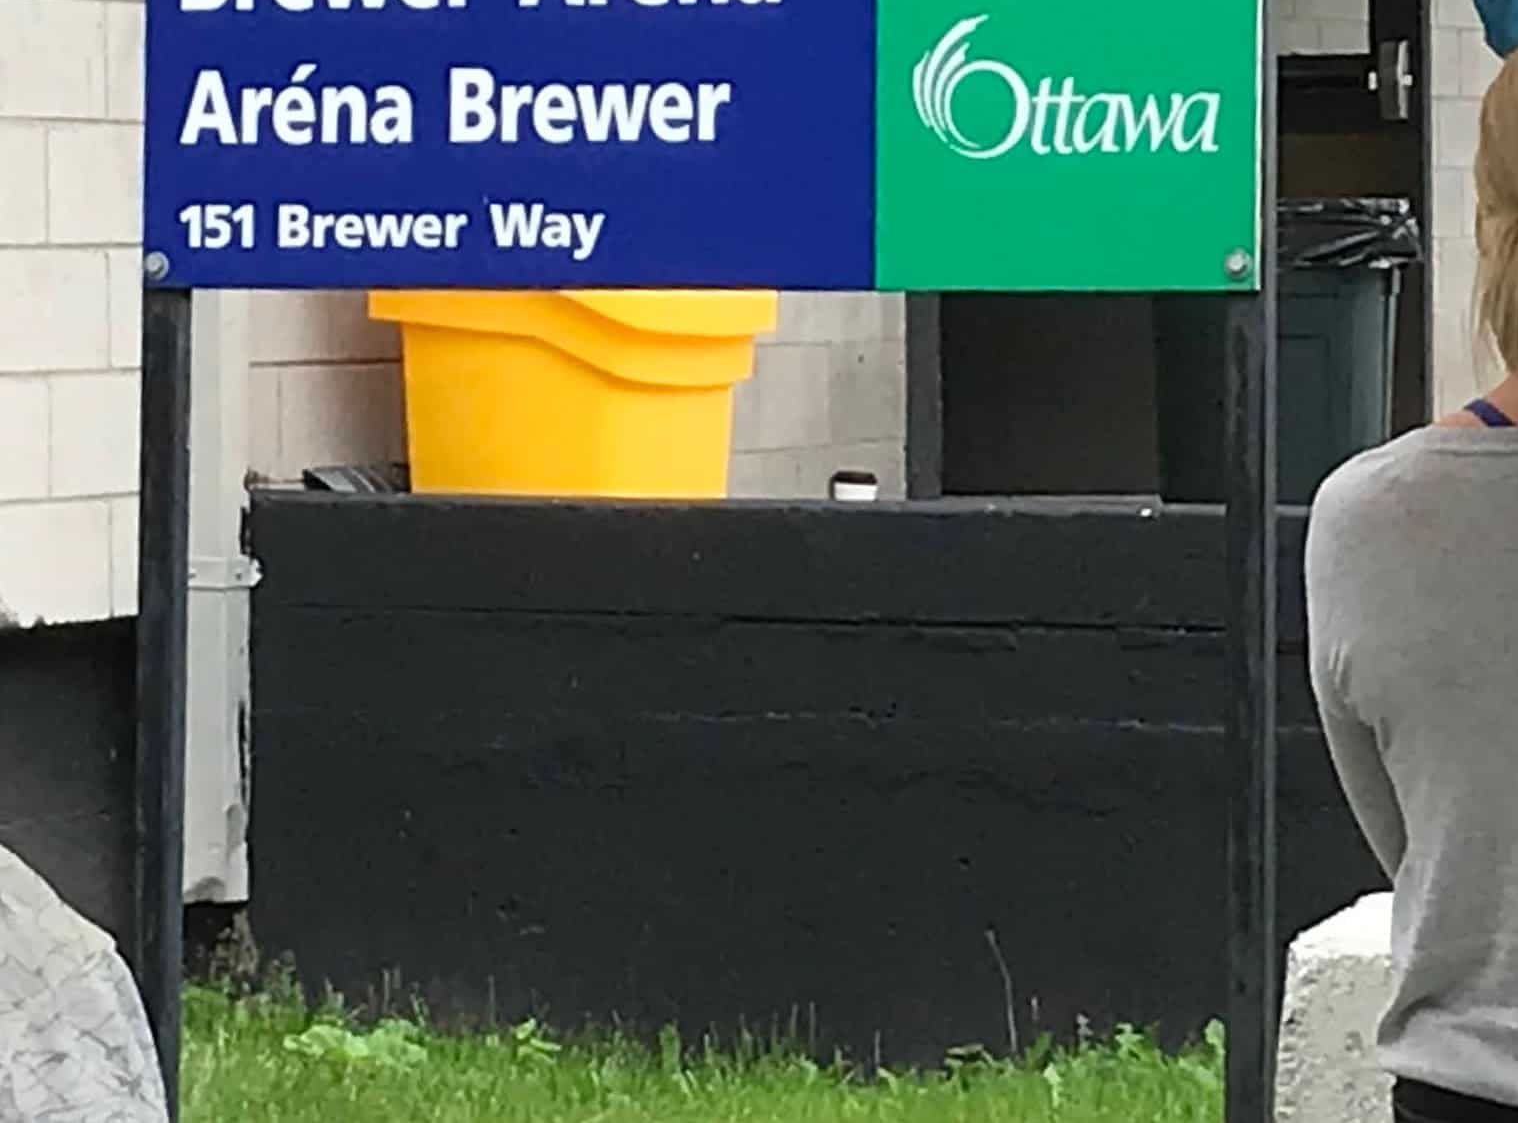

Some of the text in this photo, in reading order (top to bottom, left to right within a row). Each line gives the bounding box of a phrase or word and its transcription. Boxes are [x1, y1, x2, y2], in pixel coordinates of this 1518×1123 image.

[179, 63, 732, 146] Aréna Brewer
[912, 13, 1222, 160] Ottawa
[179, 203, 605, 261] 151 Brewer Way
